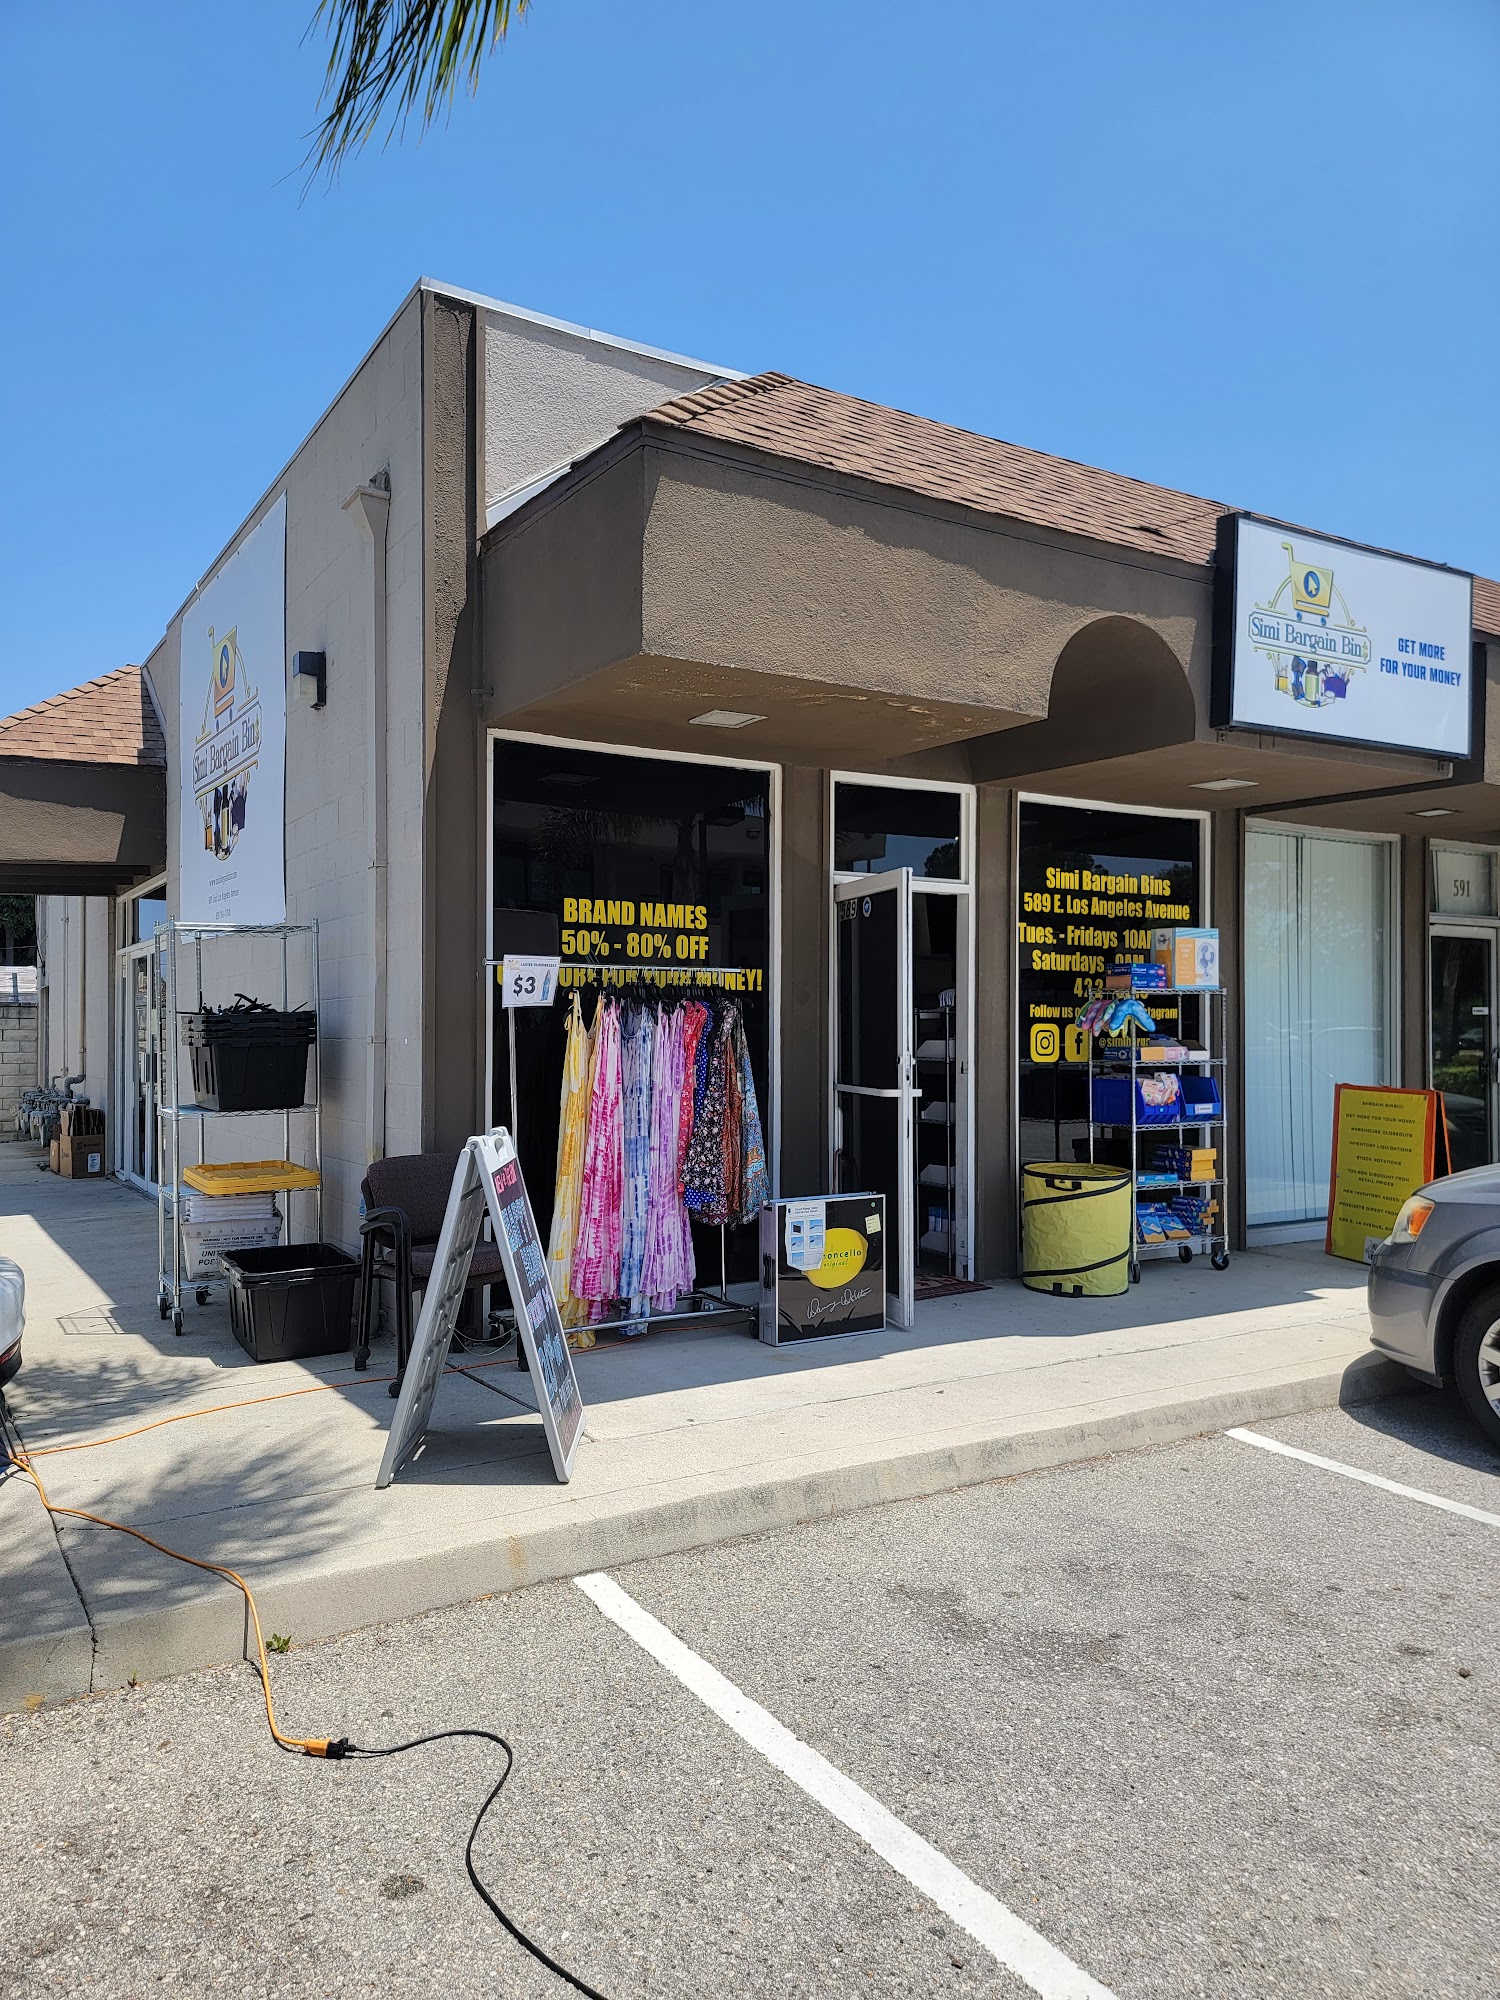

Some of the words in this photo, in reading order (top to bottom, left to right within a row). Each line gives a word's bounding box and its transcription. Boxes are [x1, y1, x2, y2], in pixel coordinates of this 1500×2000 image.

[1252, 617, 1280, 641] Simi
[1285, 624, 1336, 654] Bargain
[1398, 638, 1417, 655] GET
[1419, 641, 1445, 661] MORE
[1380, 657, 1399, 675] FOR
[1401, 661, 1427, 680] YOUR
[1429, 666, 1461, 687] MONEY
[194, 749, 208, 784] Simi
[210, 729, 239, 774] Bargain
[1046, 867, 1080, 890] Simi
[1082, 872, 1138, 895] Bargain
[1141, 875, 1171, 897] Bins
[1453, 879, 1470, 897] 591
[563, 898, 635, 926] BRAND
[640, 902, 708, 929] NAMES
[840, 899, 857, 919] 589
[1023, 892, 1051, 913] 589
[1054, 895, 1064, 914] E.
[1067, 895, 1089, 915] Los
[1091, 896, 1143, 919] Angeles
[1145, 900, 1190, 920] Avenue
[562, 929, 609, 956] 50%
[626, 932, 671, 959] 80%
[676, 935, 709, 960] OFF
[1018, 922, 1057, 945] Tues.
[1067, 925, 1118, 949] Fridays
[1032, 949, 1105, 975] Saturdays
[513, 974, 536, 997] $3
[1030, 1004, 1061, 1018] Follow
[1062, 1006, 1073, 1018] us
[1382, 1130, 1413, 1138] CLOSEOUTS
[1377, 1144, 1412, 1153] LIQUIDATIONS
[1374, 1158, 1401, 1166] ROTATIONS
[1339, 1201, 1365, 1210] PRODUCTS
